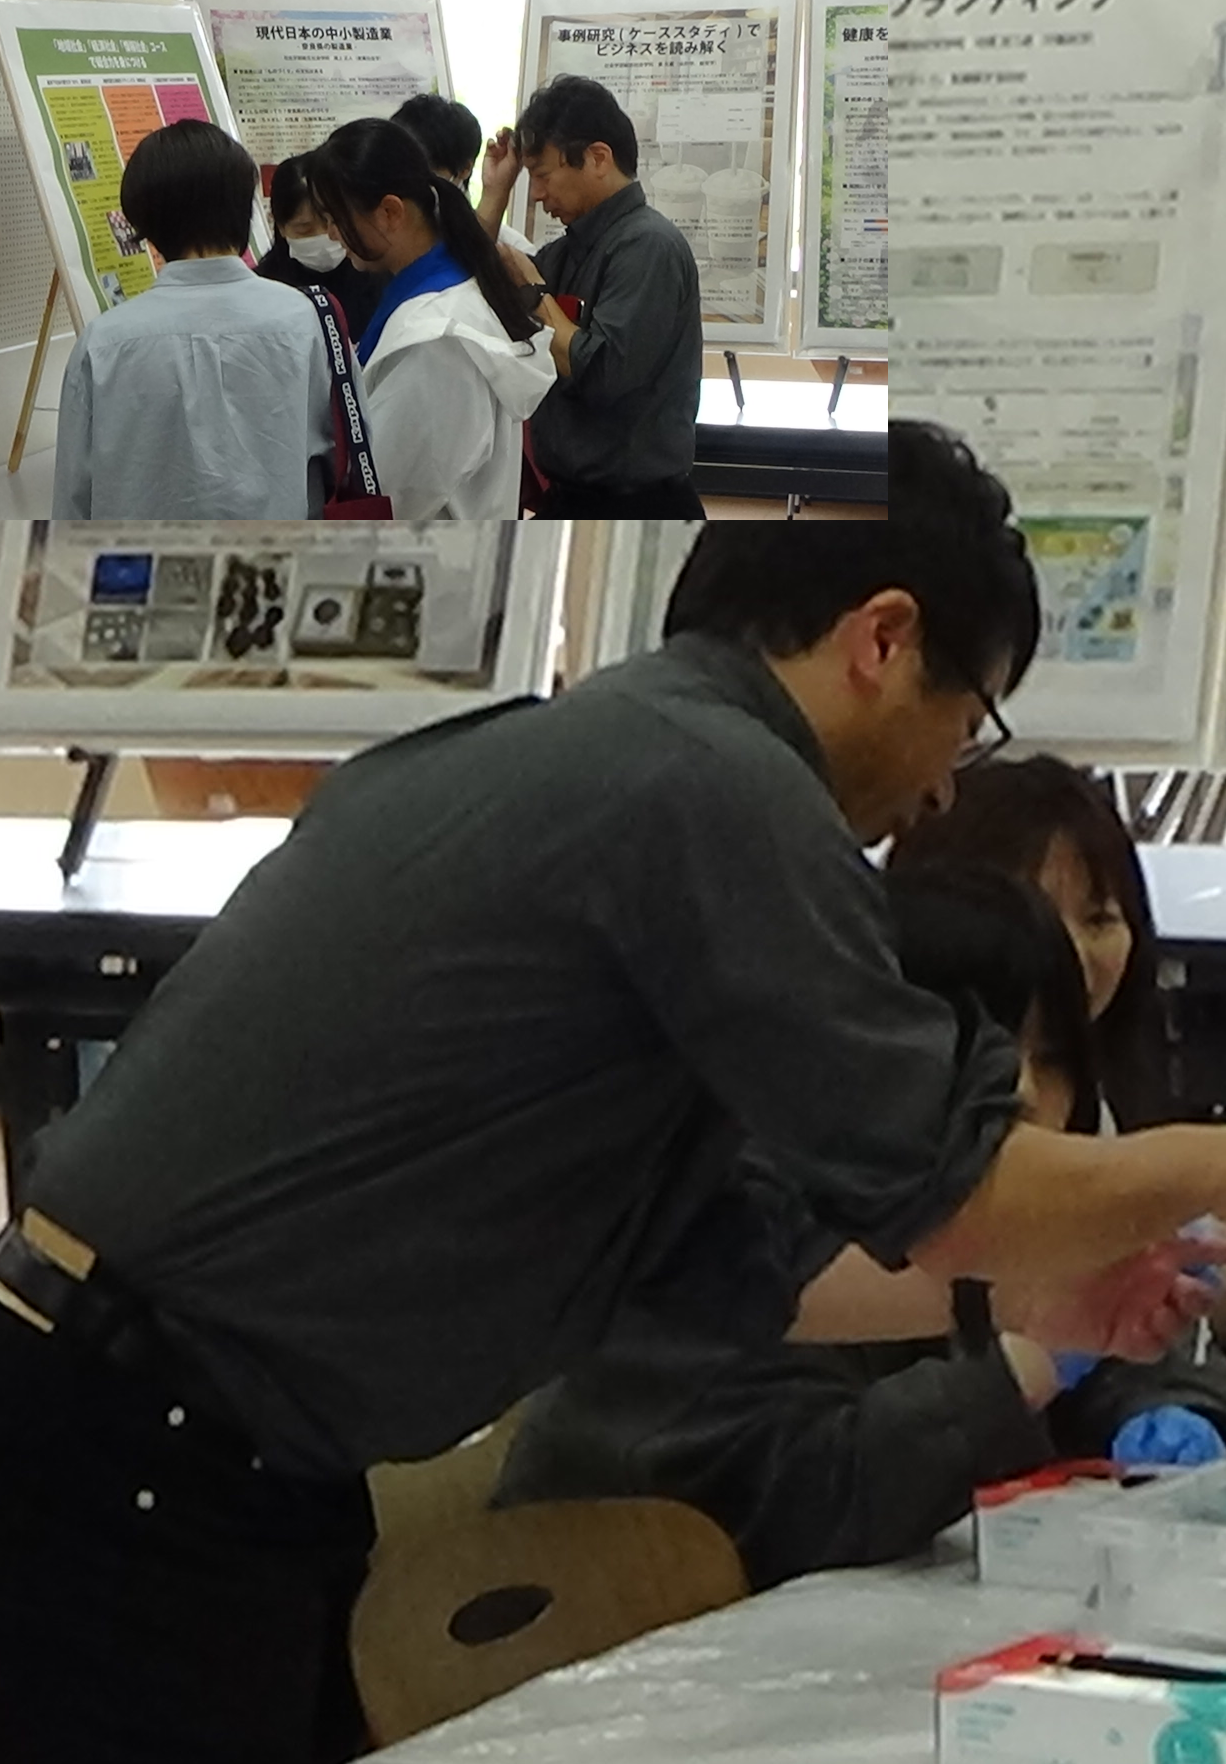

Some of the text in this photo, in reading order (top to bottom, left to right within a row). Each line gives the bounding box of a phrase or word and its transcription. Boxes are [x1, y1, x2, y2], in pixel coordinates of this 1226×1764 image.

[255, 25, 393, 41] 現代日本の中小製造業
[842, 26, 888, 42] 健康を
[597, 40, 727, 57] ビジネスを読み解く
[358, 451, 376, 496] appa
